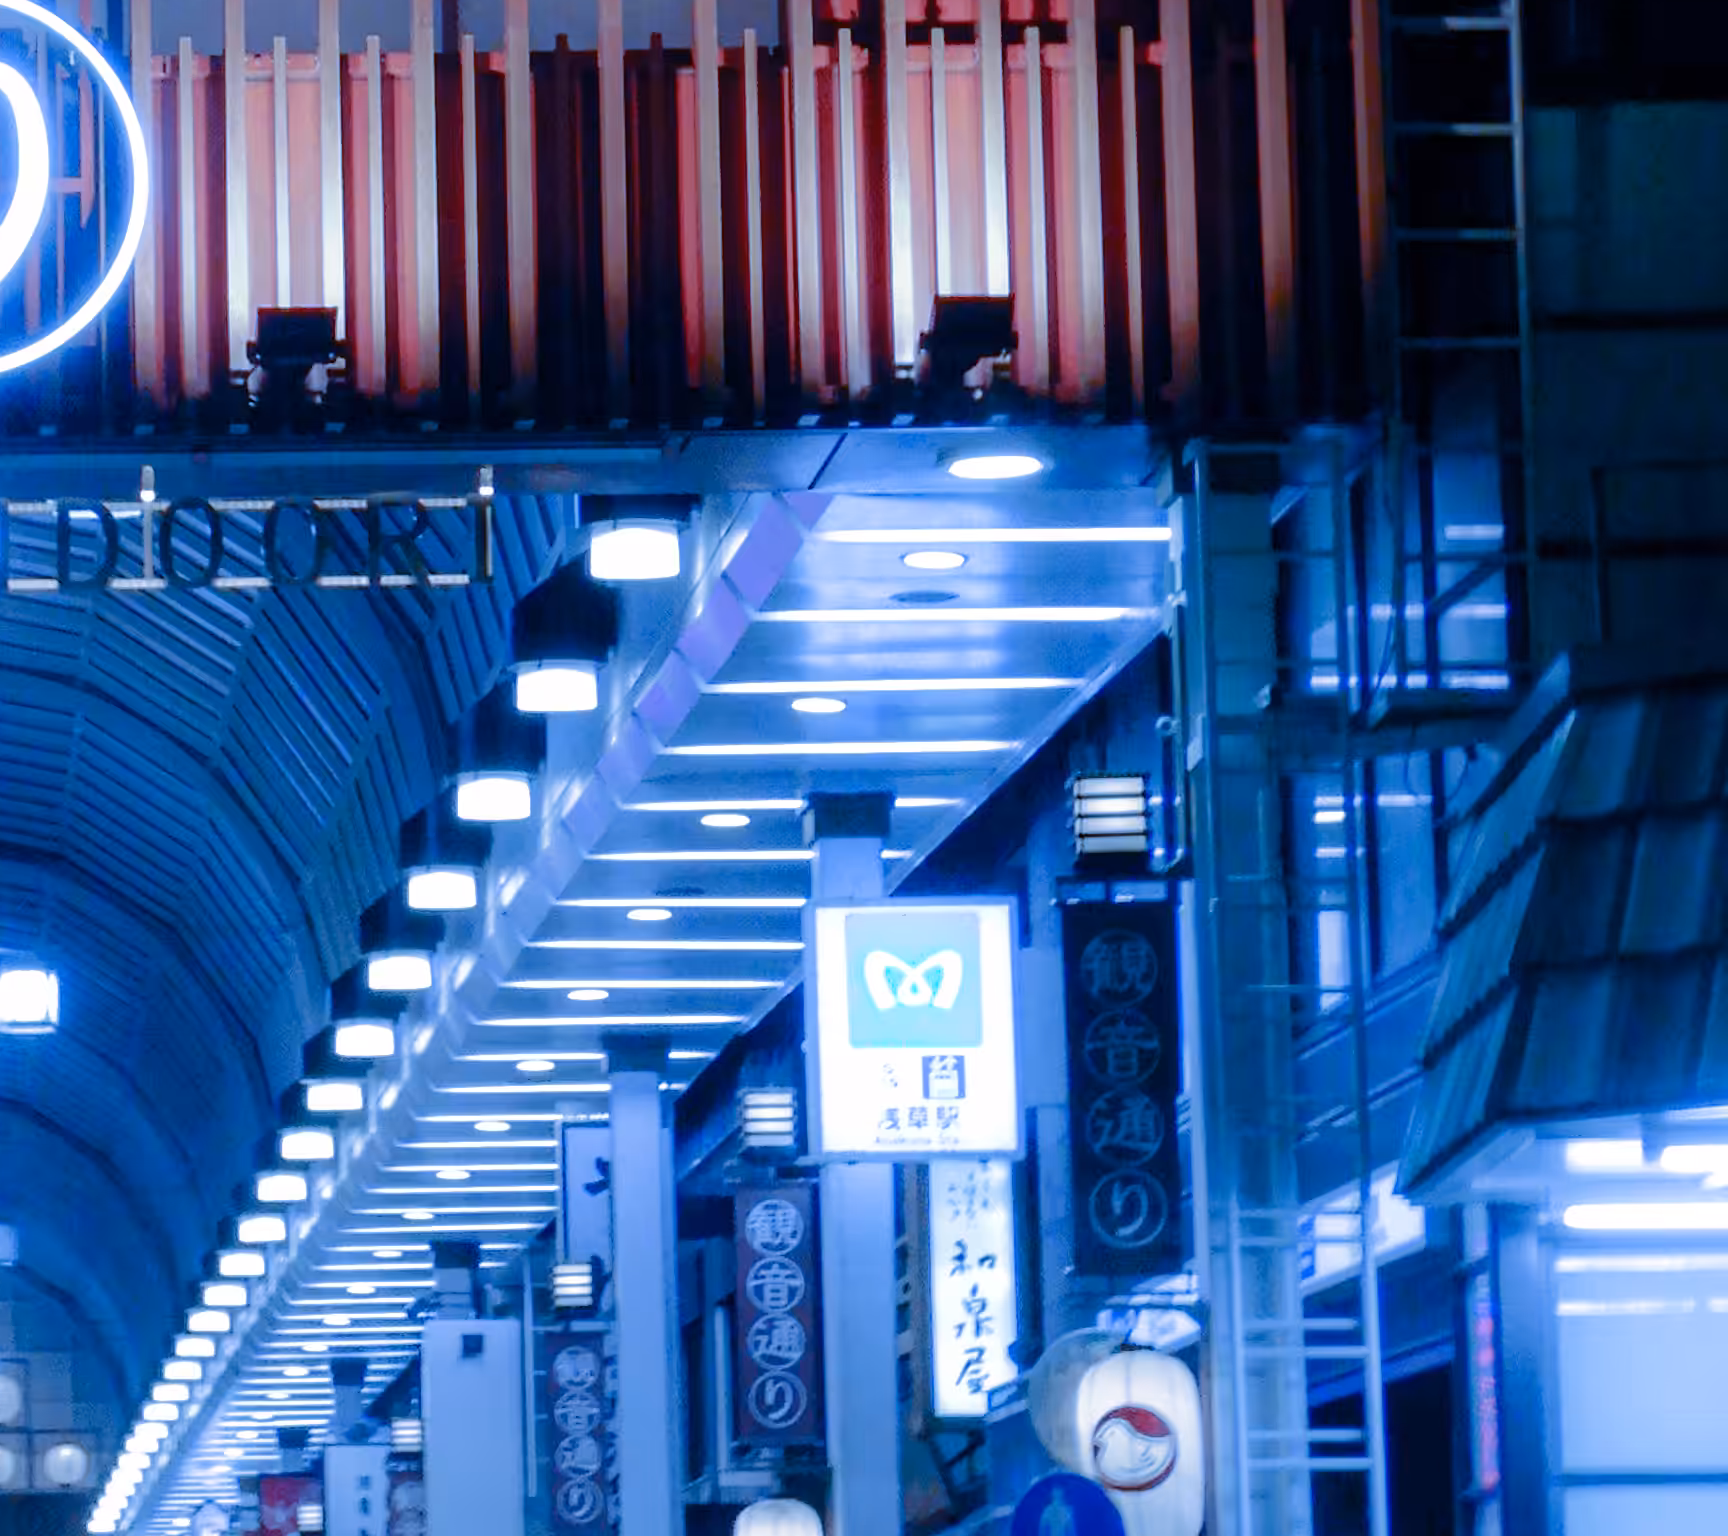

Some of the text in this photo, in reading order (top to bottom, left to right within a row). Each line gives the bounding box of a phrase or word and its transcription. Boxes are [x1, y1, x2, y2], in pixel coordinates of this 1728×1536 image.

[54, 494, 494, 590] DOORI
[1082, 931, 1168, 1246] 観音通り
[745, 1201, 807, 1427] 観音通り
